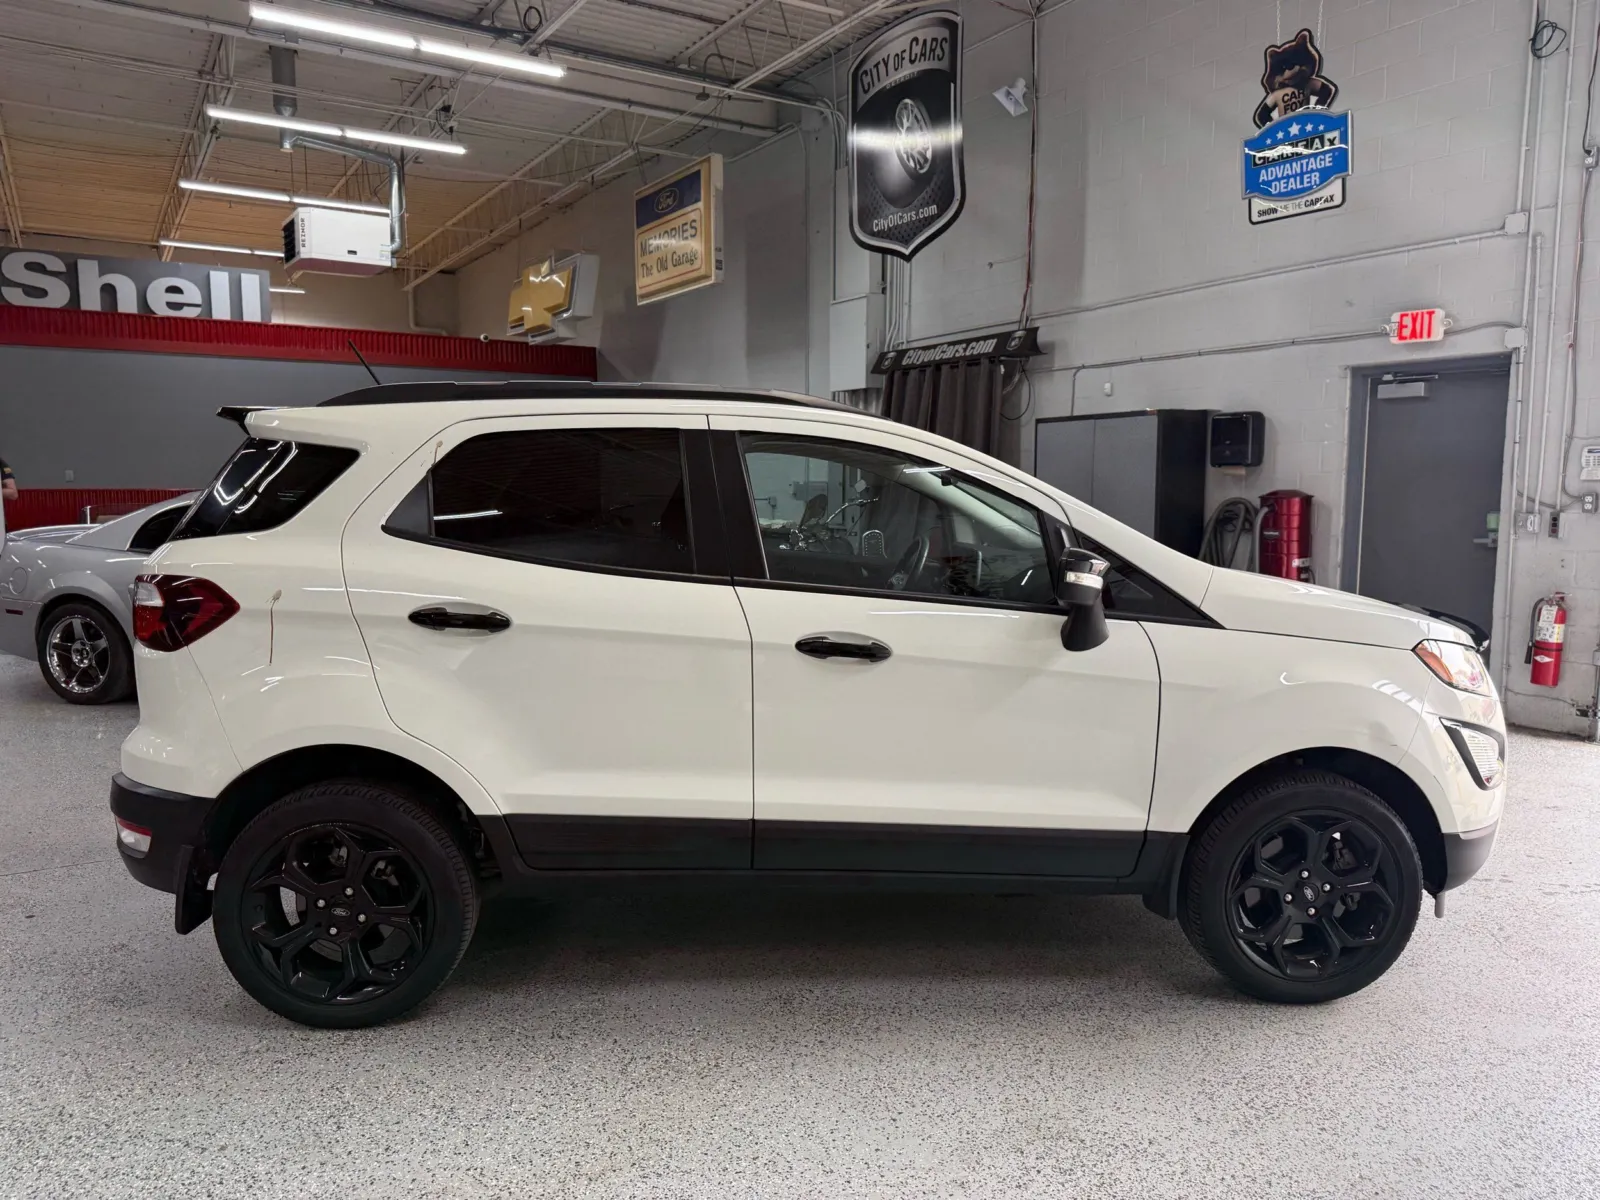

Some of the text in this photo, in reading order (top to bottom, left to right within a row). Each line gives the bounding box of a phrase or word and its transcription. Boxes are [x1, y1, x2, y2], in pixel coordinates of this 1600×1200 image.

[860, 36, 949, 94] CITY OF CARS
[1281, 89, 1306, 104] CAR
[1259, 153, 1333, 182] ADVANTAGE
[1271, 172, 1320, 194] DEALER
[872, 204, 938, 232] CityOfCars.com
[1257, 206, 1279, 218] SHOW
[1291, 201, 1304, 211] THE
[1304, 194, 1335, 208] CARFAX
[639, 219, 698, 258] MEMORIES
[641, 262, 653, 279] The
[656, 256, 668, 273] Old
[671, 247, 699, 268] Garage
[1, 251, 262, 323] Shell
[1398, 309, 1436, 341] EXIT
[901, 338, 998, 366] CityofCars.com
